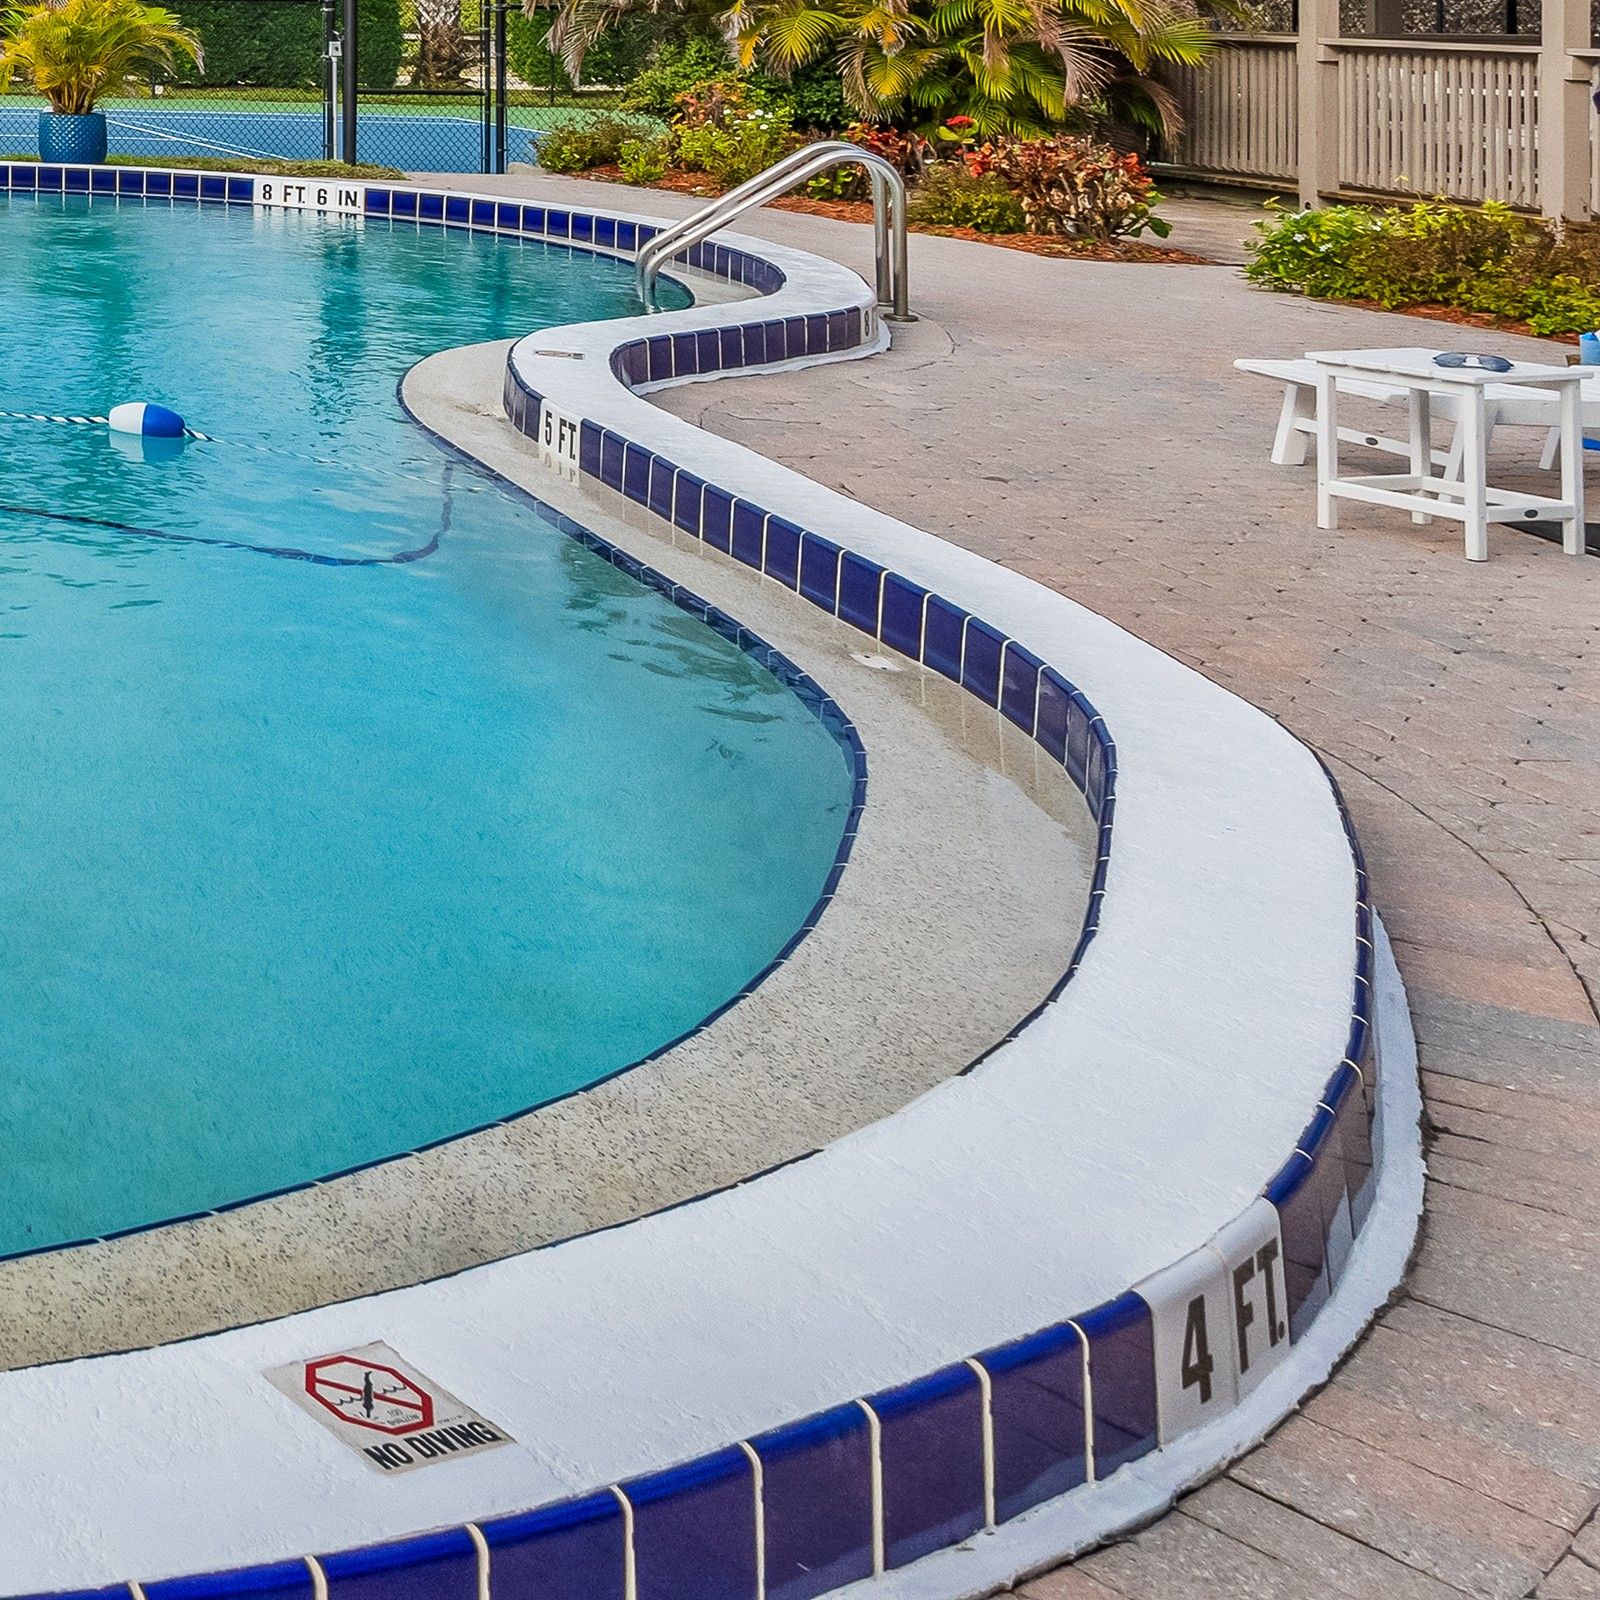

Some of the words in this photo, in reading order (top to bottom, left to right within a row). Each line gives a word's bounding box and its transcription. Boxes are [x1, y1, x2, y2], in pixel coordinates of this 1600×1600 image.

[262, 184, 272, 201] 8
[284, 185, 306, 204] FT.
[317, 188, 328, 205] 6
[339, 190, 361, 208] IN.
[864, 310, 870, 337] 8
[545, 409, 553, 446] 5
[558, 417, 577, 461] FT.
[1181, 1294, 1214, 1405] 4
[1232, 1237, 1285, 1375] FT.
[362, 1442, 415, 1470] NO
[403, 1420, 503, 1460] DIVING
